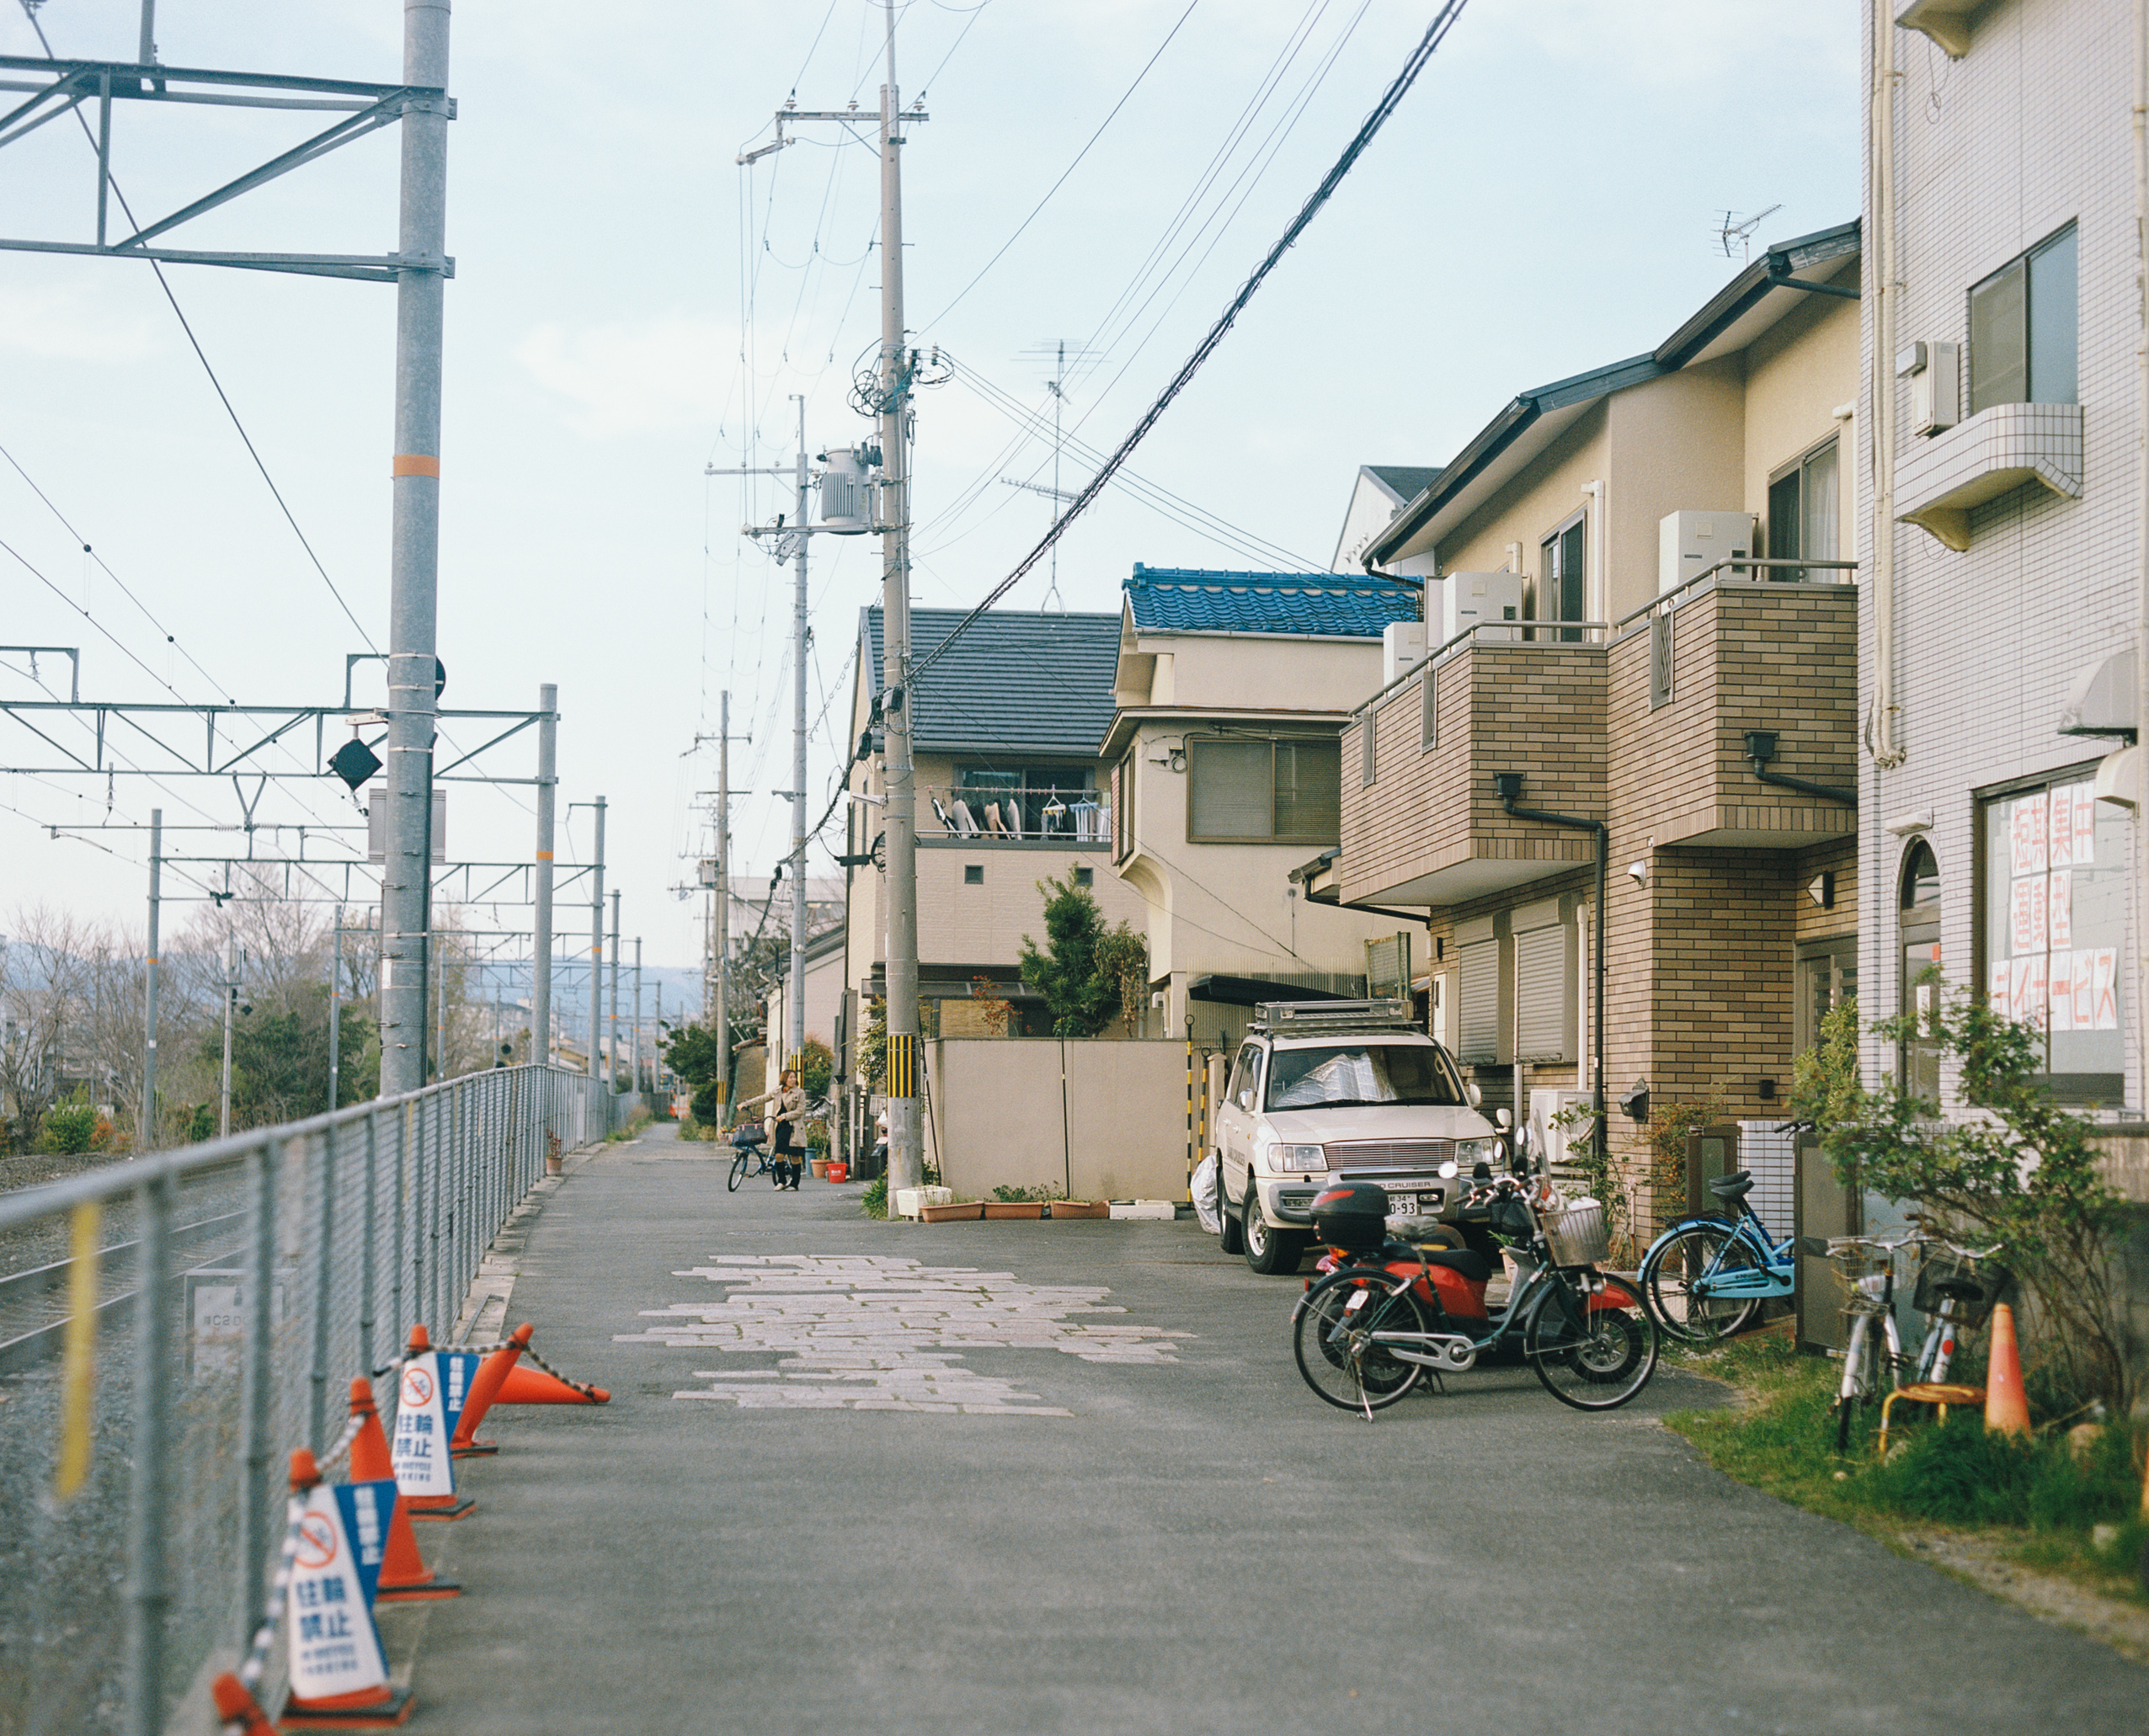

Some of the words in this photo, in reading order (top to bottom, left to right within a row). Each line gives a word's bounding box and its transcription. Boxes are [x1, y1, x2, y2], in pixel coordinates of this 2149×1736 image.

[2013, 789, 2093, 871] 短期集中
[2013, 874, 2070, 948] 運動型
[1993, 954, 2115, 1025] デイサービス
[1389, 1202, 1415, 1214] 0-93
